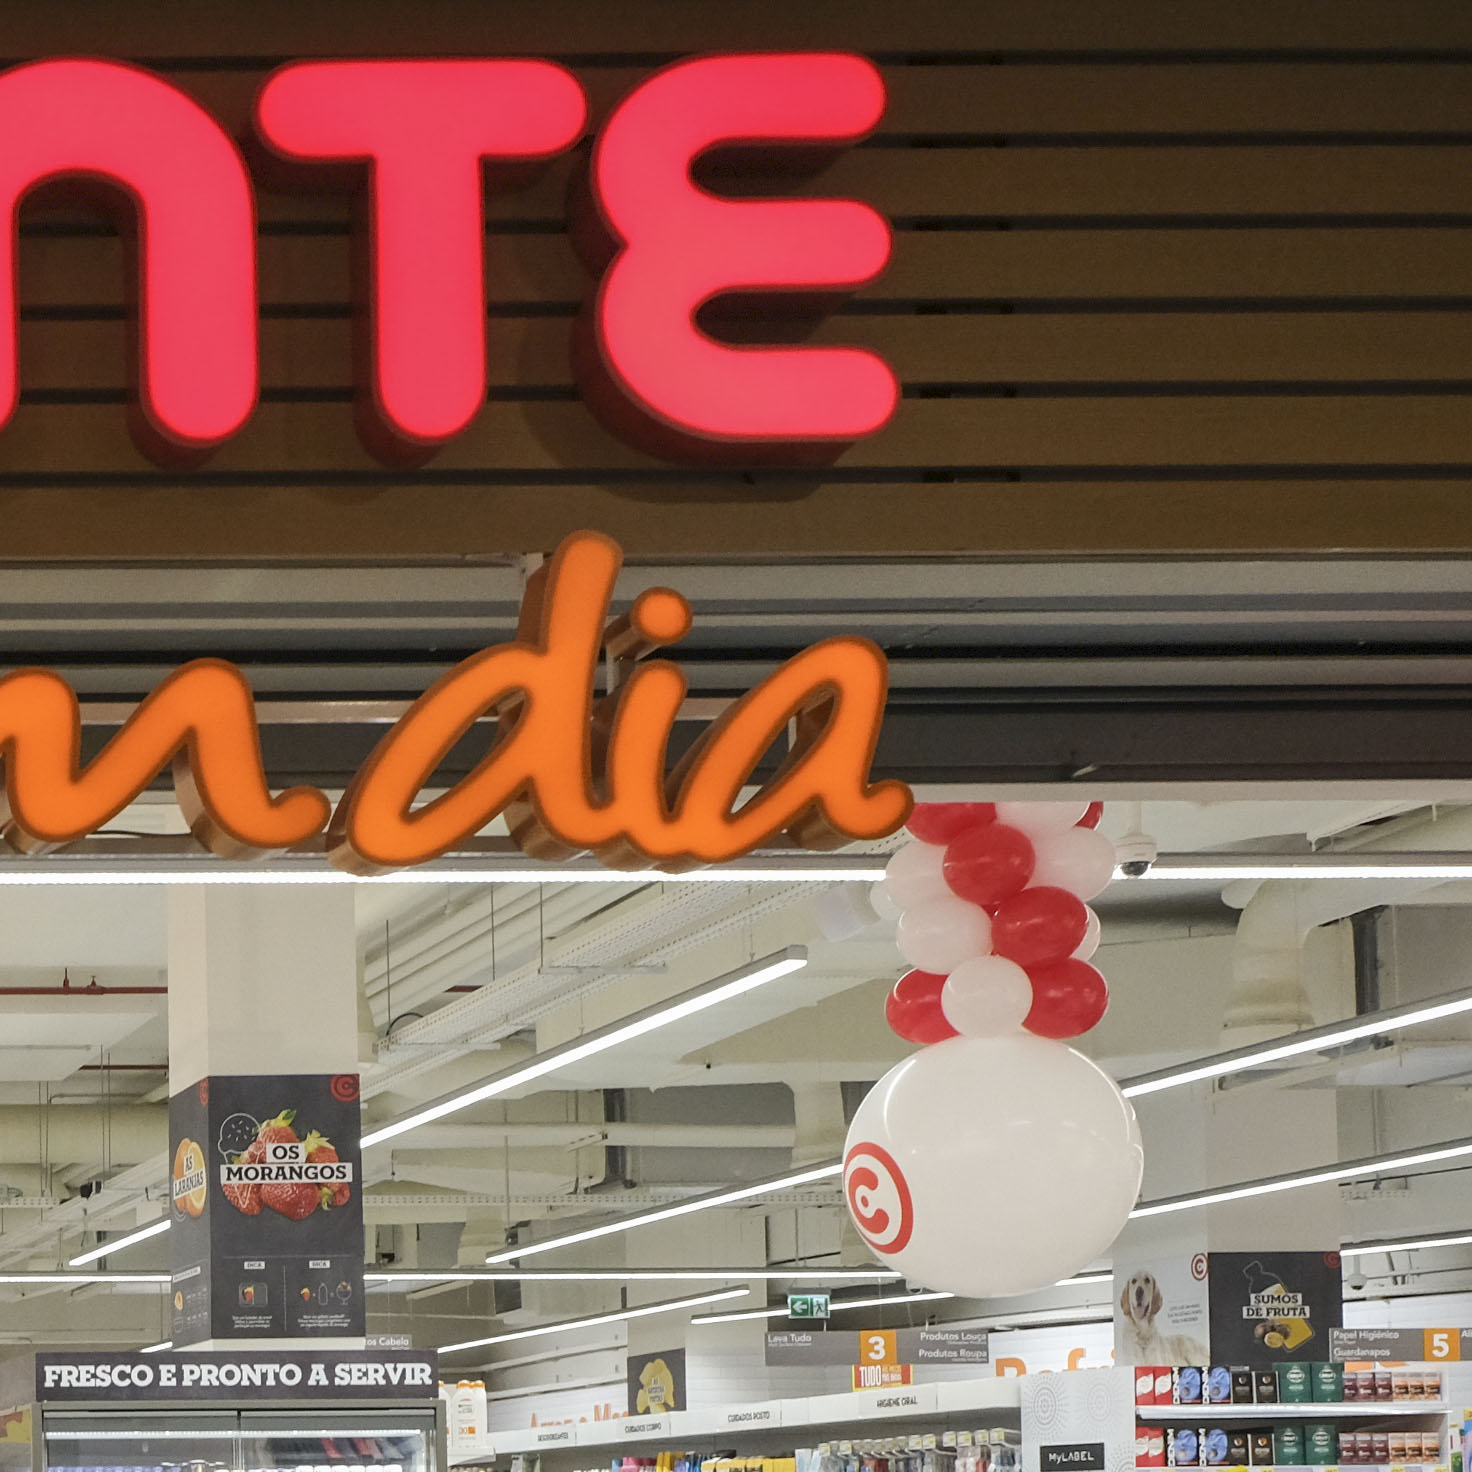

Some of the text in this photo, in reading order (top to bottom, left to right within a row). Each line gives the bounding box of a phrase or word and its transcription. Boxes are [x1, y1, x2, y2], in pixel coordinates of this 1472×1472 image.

[326, 530, 915, 876] dia
[272, 1145, 300, 1161] OS
[225, 1165, 347, 1182] MORANGOS
[173, 1170, 205, 1197] LARANJAS
[1253, 1294, 1299, 1305] SUMOS
[1246, 1306, 1308, 1318] DE FRUTA
[378, 1336, 409, 1347] Cabelo
[789, 1334, 812, 1343] Tudo
[920, 1331, 960, 1342] Produtos
[1333, 1330, 1357, 1341] Papel
[868, 1335, 887, 1361] 3
[1333, 1347, 1391, 1358] Guardanapos
[1432, 1333, 1450, 1358] 5
[919, 1349, 958, 1359] Produtos
[44, 1361, 433, 1388] FRESCO E PRONTO A SERVIR
[859, 1365, 881, 1387] TUDO
